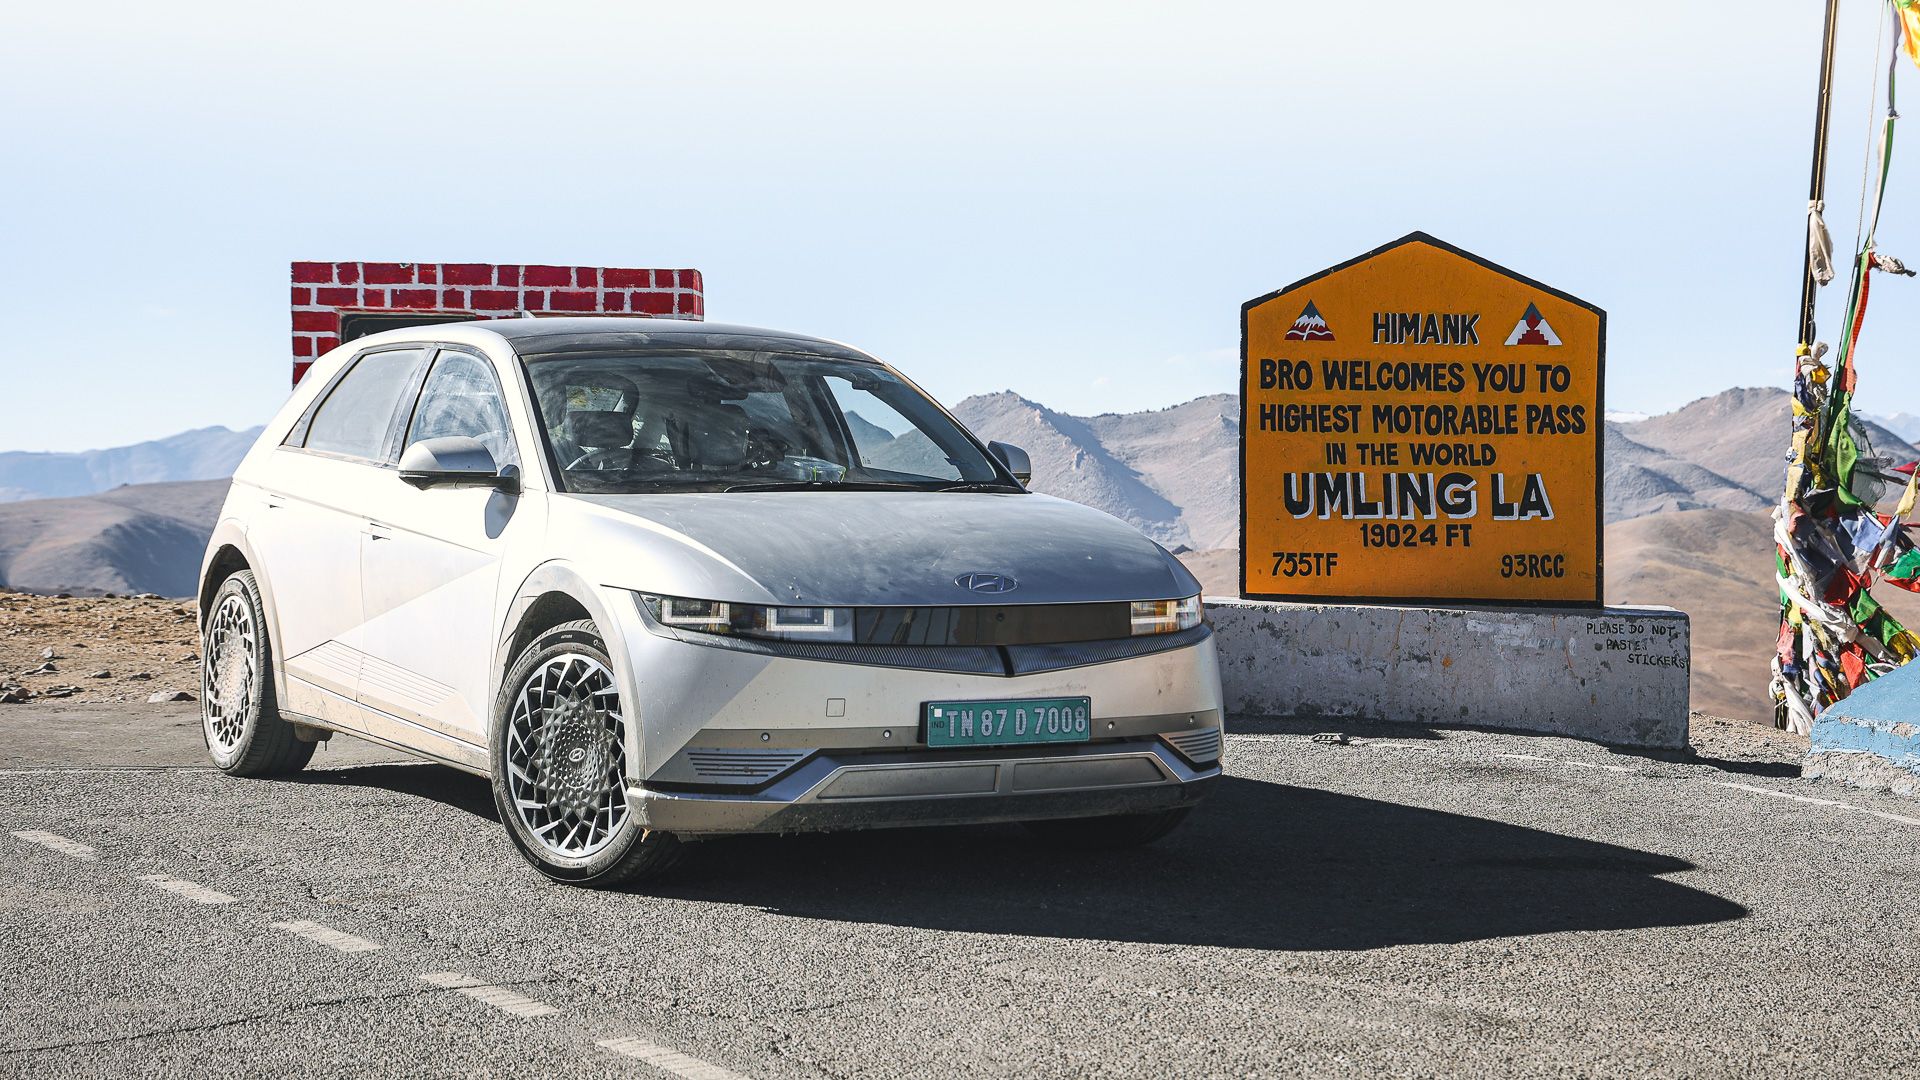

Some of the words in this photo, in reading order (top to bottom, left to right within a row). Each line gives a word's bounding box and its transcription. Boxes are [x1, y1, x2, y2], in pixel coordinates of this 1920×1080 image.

[1373, 312, 1480, 345] HIMANK
[1259, 358, 1313, 390] BRO
[1322, 360, 1465, 392] WELCOMES
[1472, 363, 1526, 393] YOU
[1535, 364, 1571, 393] TO
[1259, 403, 1361, 433] HIGHEST
[1373, 404, 1518, 435] MOTORABLE
[1526, 404, 1586, 434] PASS
[1326, 443, 1347, 465] IN
[1356, 443, 1398, 466] THE
[1410, 443, 1497, 466] WORLD
[1283, 472, 1477, 520] UMLING
[1491, 472, 1554, 520] LA
[1360, 523, 1438, 547] 19024
[1446, 524, 1472, 547] FT
[1271, 552, 1338, 577] 755TF
[1586, 622, 1625, 635] PLEASE
[1629, 624, 1644, 634] DO
[1651, 625, 1676, 637] NOT
[1627, 653, 1686, 669] STICKERS
[931, 721, 945, 729] IND
[946, 710, 974, 737] TN
[981, 708, 1008, 737] 87
[1015, 708, 1027, 736] D
[1033, 706, 1086, 735] 7008
